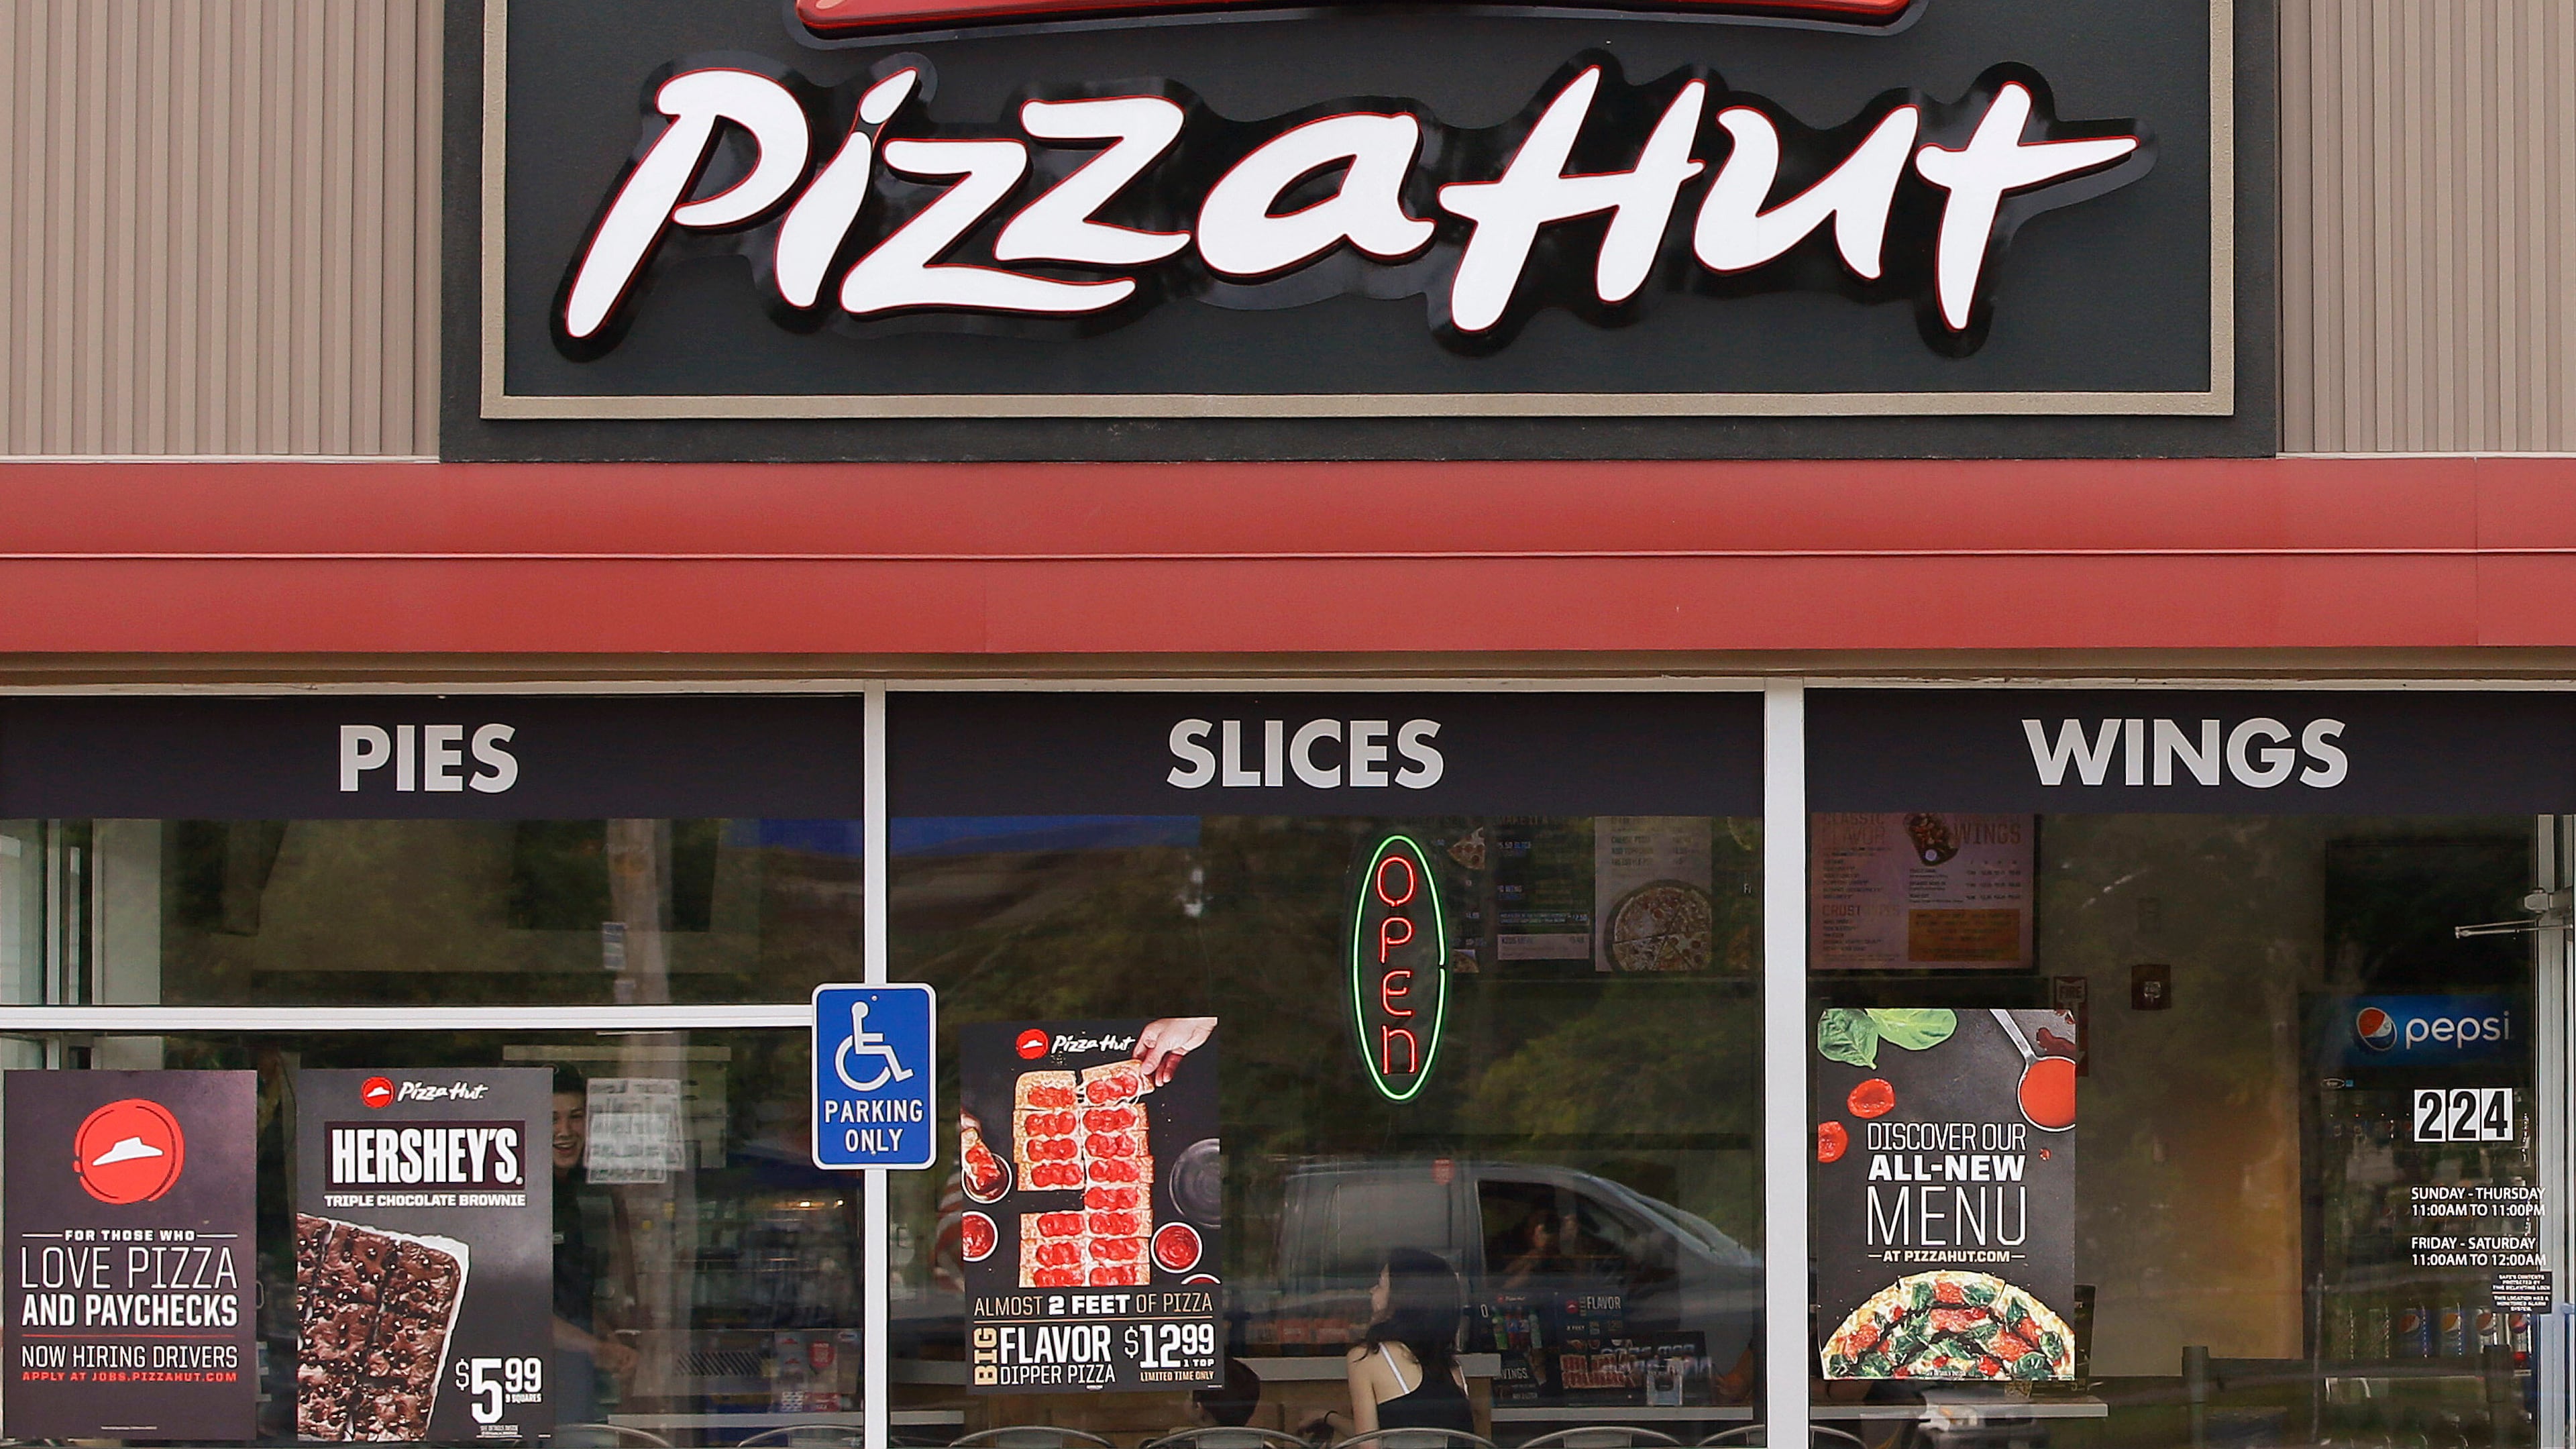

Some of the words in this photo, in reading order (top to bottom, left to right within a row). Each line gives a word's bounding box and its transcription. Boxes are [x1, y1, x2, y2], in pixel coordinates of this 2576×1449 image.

[565, 66, 1434, 338] Pizza
[1437, 64, 2140, 333] Hut
[339, 723, 519, 794] PIES
[1166, 718, 1444, 790] SLICES
[2021, 717, 2349, 789] WINGS
[1953, 822, 2022, 845] WINGS
[2059, 985, 2083, 999] FIRE
[2405, 1010, 2511, 1049] pepsi
[1051, 1035, 1099, 1055] Pizza
[1099, 1034, 1136, 1053] Hut
[396, 1081, 448, 1101] Pizza
[448, 1081, 489, 1100] Hut
[824, 1099, 924, 1124] PARKING
[2418, 1090, 2509, 1140] 224
[845, 1128, 904, 1152] ONLY
[1867, 1122, 1976, 1151] DISCOVER
[1982, 1122, 2027, 1151] OUR
[331, 1128, 520, 1185] HERSHEY'S
[1868, 1154, 2026, 1181] ALL-NEW
[324, 1195, 374, 1208] TRIPLE
[376, 1195, 457, 1207] CHOCOLATE
[459, 1195, 526, 1207] BROWNIE
[2410, 1187, 2465, 1200] SUNDAY
[2475, 1187, 2546, 1200] THURSDAY
[1866, 1185, 2027, 1246] MENU
[2412, 1203, 2467, 1217] 11:00AM
[2469, 1203, 2488, 1217] TO
[2491, 1203, 2546, 1217] 11:00PM
[64, 1229, 95, 1241] FOR
[101, 1229, 154, 1241] THOSE
[160, 1229, 196, 1241] WHO
[2411, 1236, 2458, 1250] FRIDAY
[2468, 1236, 2536, 1250] SATURDAY
[21, 1246, 111, 1289] LOVE
[128, 1246, 237, 1289] PIZZA
[1883, 1250, 1901, 1263] AT
[1904, 1250, 2010, 1263] PIZZAHUT.COM
[2412, 1253, 2467, 1267] 11:00AM
[2469, 1253, 2488, 1267] TO
[2491, 1253, 2546, 1267] 12:00AM
[21, 1293, 76, 1326] AND
[85, 1293, 238, 1326] PAYCHECKS
[973, 1295, 1043, 1317] ALMOST
[1048, 1295, 1065, 1316] 2
[1071, 1294, 1131, 1314] FEET
[1136, 1293, 1157, 1313] OF
[1163, 1292, 1214, 1313] PIZZA
[1587, 1296, 1621, 1309] FLAVOR
[1000, 1325, 1112, 1364] FLAVOR
[21, 1345, 67, 1368] NOW
[72, 1345, 146, 1368] HIRING
[152, 1345, 238, 1368] DRIVERS
[974, 1327, 998, 1386] BIG
[1183, 1358, 1190, 1368] 1
[1192, 1358, 1215, 1367] TOP
[22, 1372, 65, 1381] APPLY
[70, 1372, 87, 1381] AT
[91, 1372, 237, 1381] JOBS.PIZZAHUT.COM
[1000, 1365, 1063, 1385] DIPPER
[1067, 1364, 1116, 1384] PIZZA
[1140, 1371, 1173, 1383] LIMITED
[1174, 1371, 1194, 1381] TIME
[1195, 1371, 1215, 1381] ONLY
[511, 1393, 542, 1403] SQUARES
